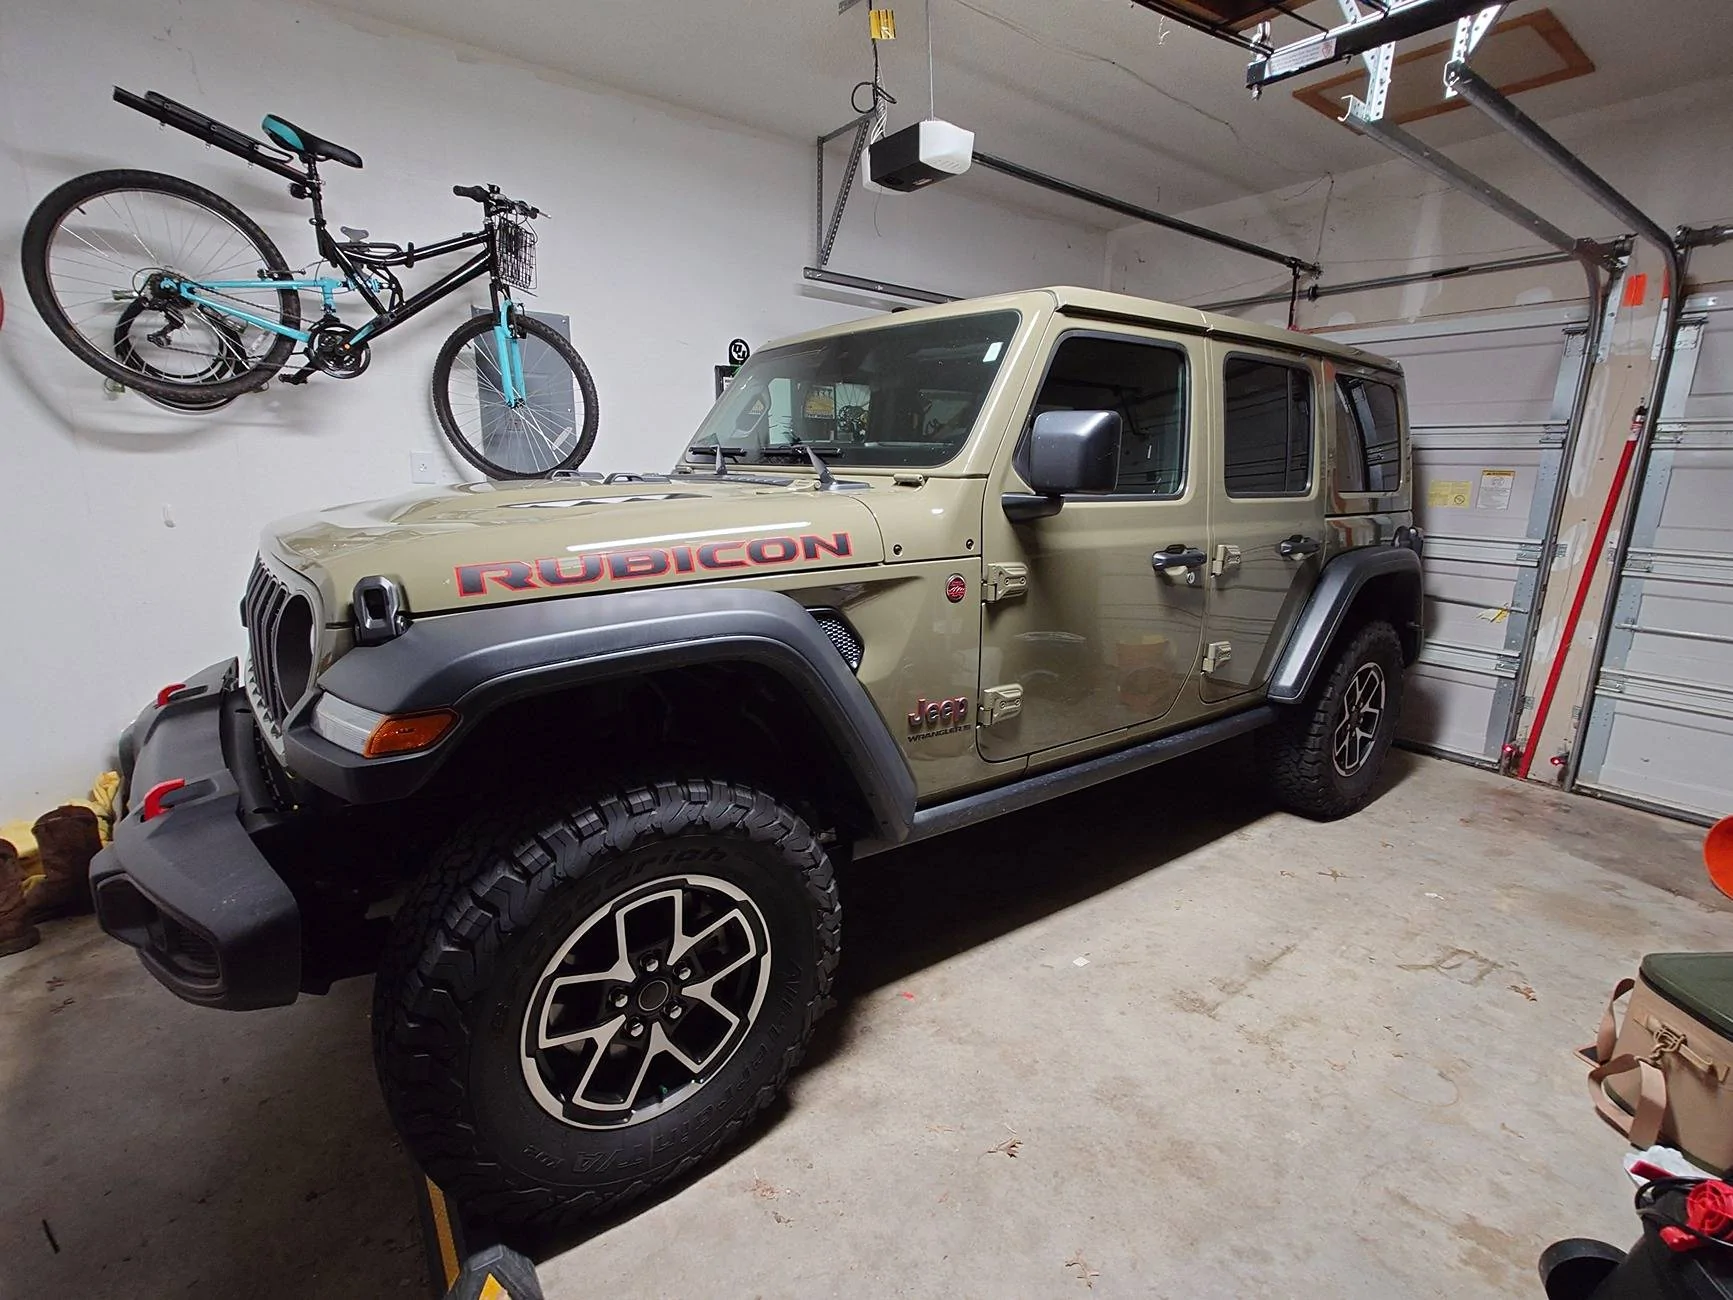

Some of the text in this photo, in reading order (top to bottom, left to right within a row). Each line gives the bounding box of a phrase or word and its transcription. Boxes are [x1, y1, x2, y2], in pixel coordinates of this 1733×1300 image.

[454, 532, 853, 598] RUBICON
[908, 696, 969, 726] Jeep
[907, 726, 962, 743] WRANGLER
